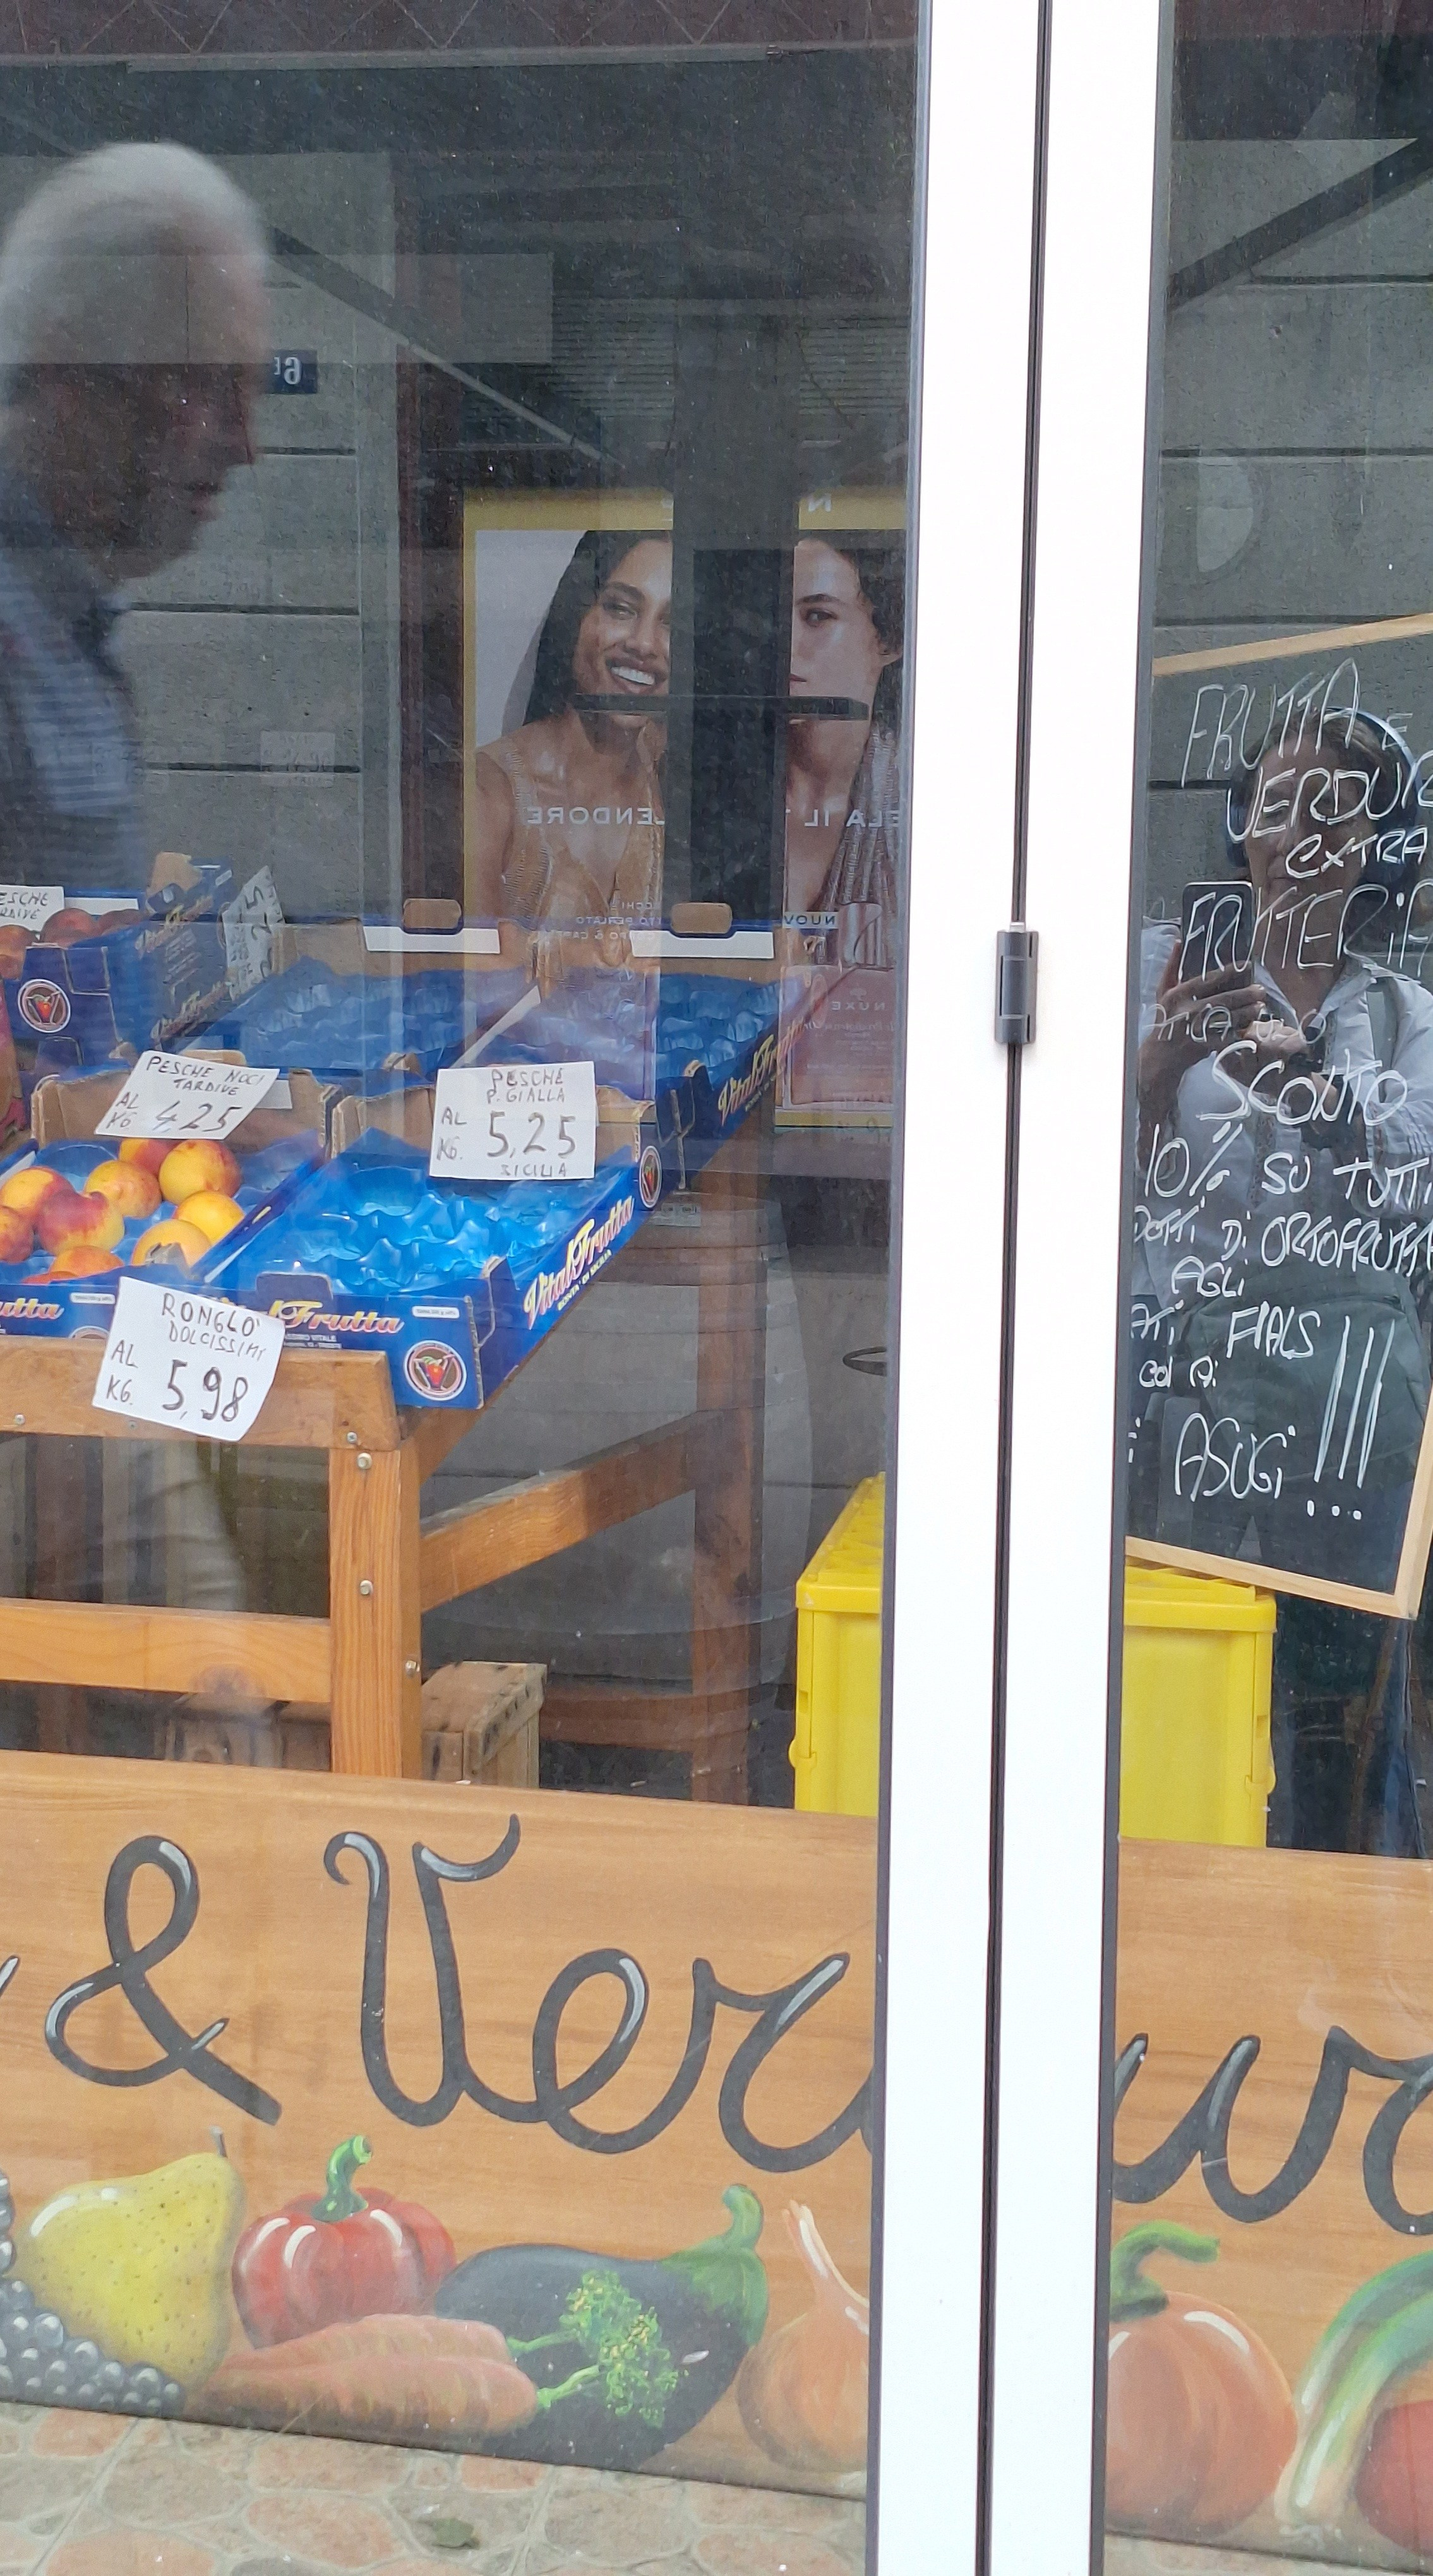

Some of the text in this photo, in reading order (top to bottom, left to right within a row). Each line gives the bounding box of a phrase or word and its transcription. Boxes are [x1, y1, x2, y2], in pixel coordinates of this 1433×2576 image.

[1181, 657, 1361, 789] FRUTTA
[146, 1055, 215, 1078] PESCHE
[491, 1067, 564, 1091] PESCHE
[173, 1078, 241, 1096] TARDIVE
[507, 1087, 565, 1103] GIALLA
[1196, 1040, 1408, 1125] SCONTO
[115, 1091, 139, 1109] AL
[441, 1106, 467, 1126] AL
[486, 1111, 577, 1160] 5,25
[1145, 1121, 1244, 1198] 10%
[1261, 1152, 1311, 1195] SU
[1226, 1300, 1321, 1360] FIALS
[111, 1339, 138, 1368] AL
[162, 1359, 249, 1422] 5,98
